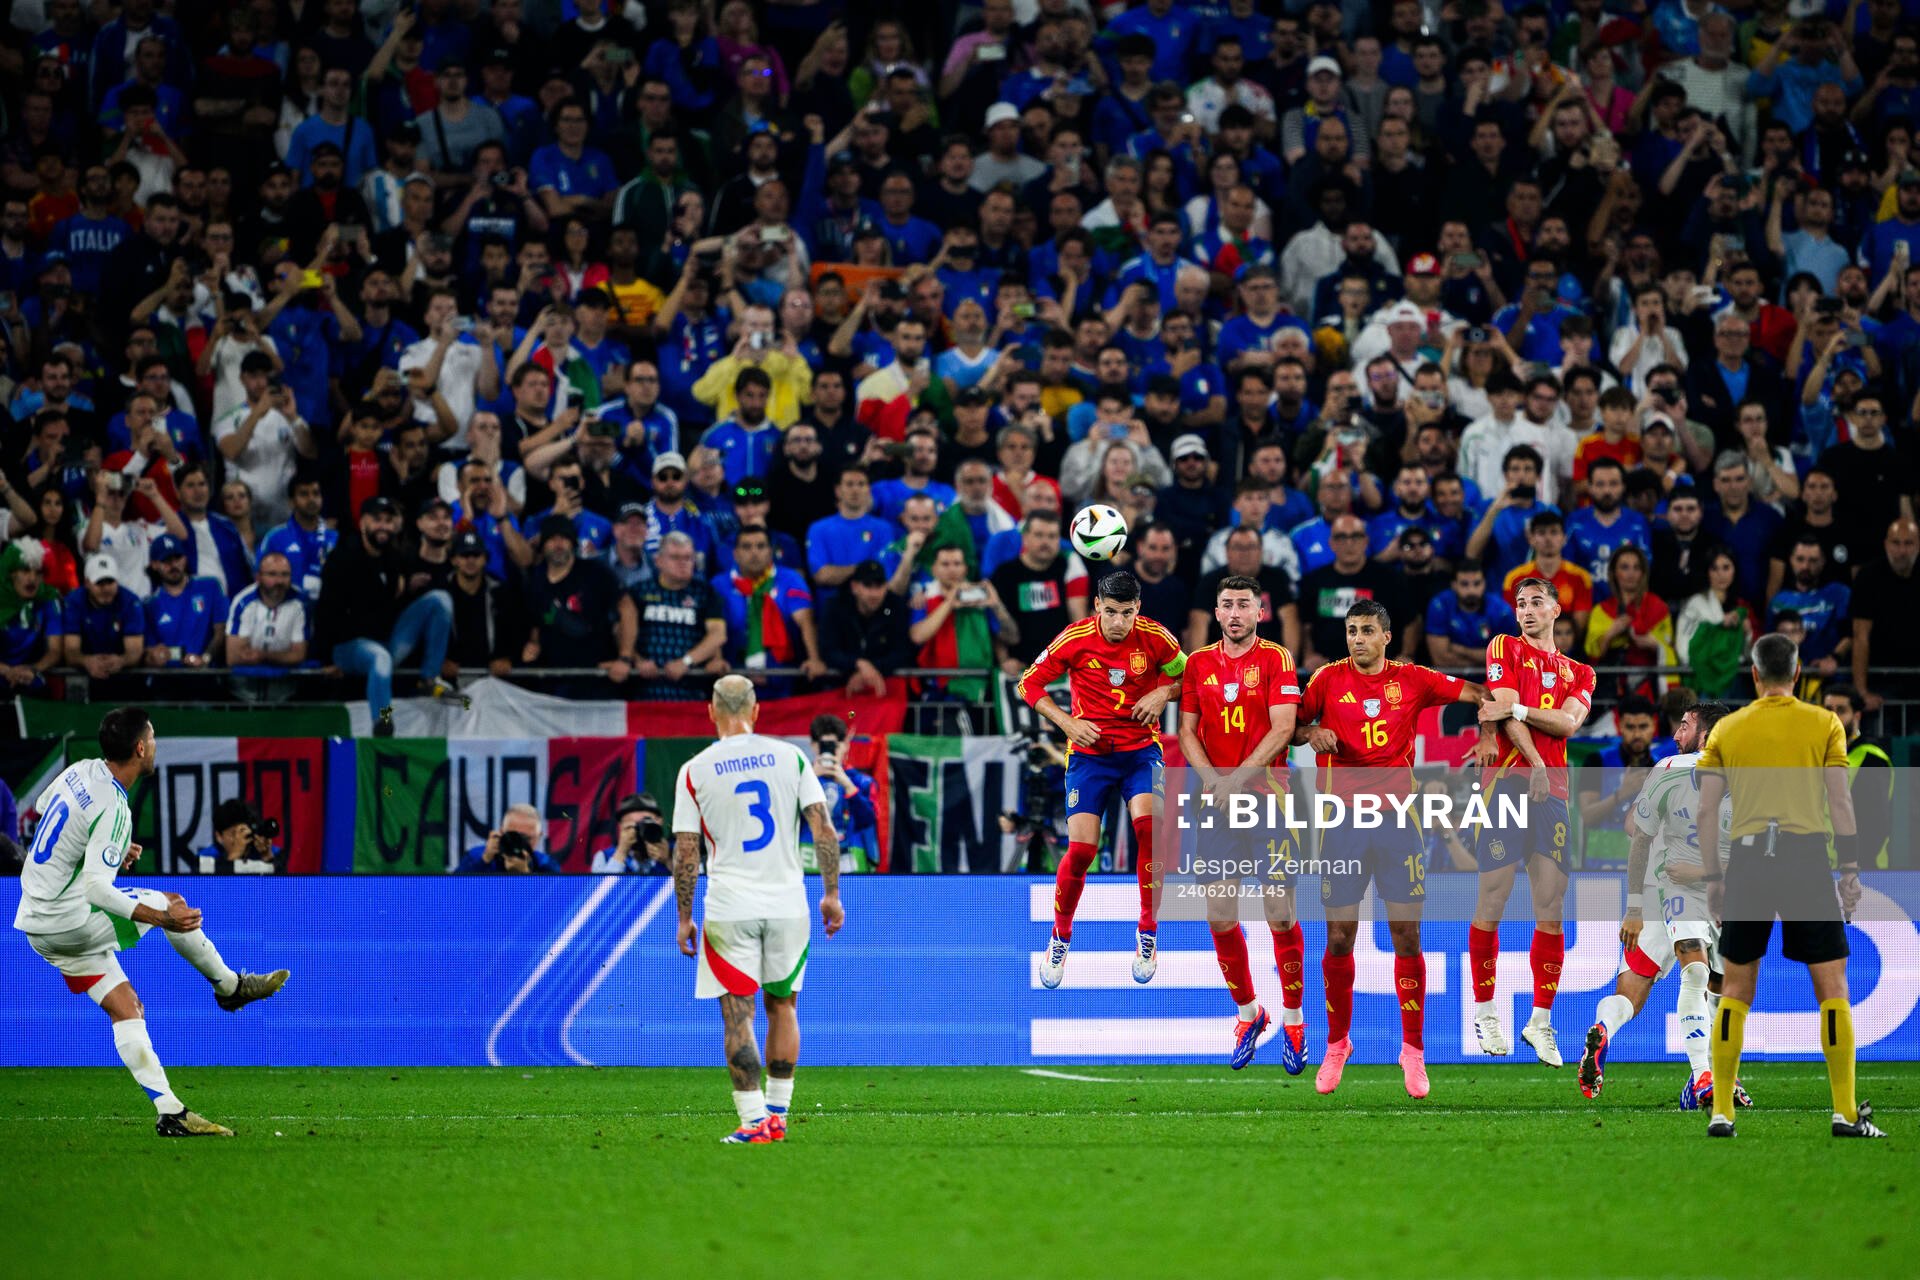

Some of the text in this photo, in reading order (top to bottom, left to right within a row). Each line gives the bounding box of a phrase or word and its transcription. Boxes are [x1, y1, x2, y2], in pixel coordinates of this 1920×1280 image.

[1110, 688, 1126, 711] 7
[1220, 706, 1246, 734] 14
[1360, 719, 1389, 749] 16
[714, 753, 776, 776] DIMARCO
[28, 793, 69, 864] 10
[734, 780, 775, 853] 3
[1553, 822, 1567, 847] 8
[1266, 838, 1292, 866] 14
[1403, 852, 1425, 882] 16
[1662, 895, 1685, 926] 20
